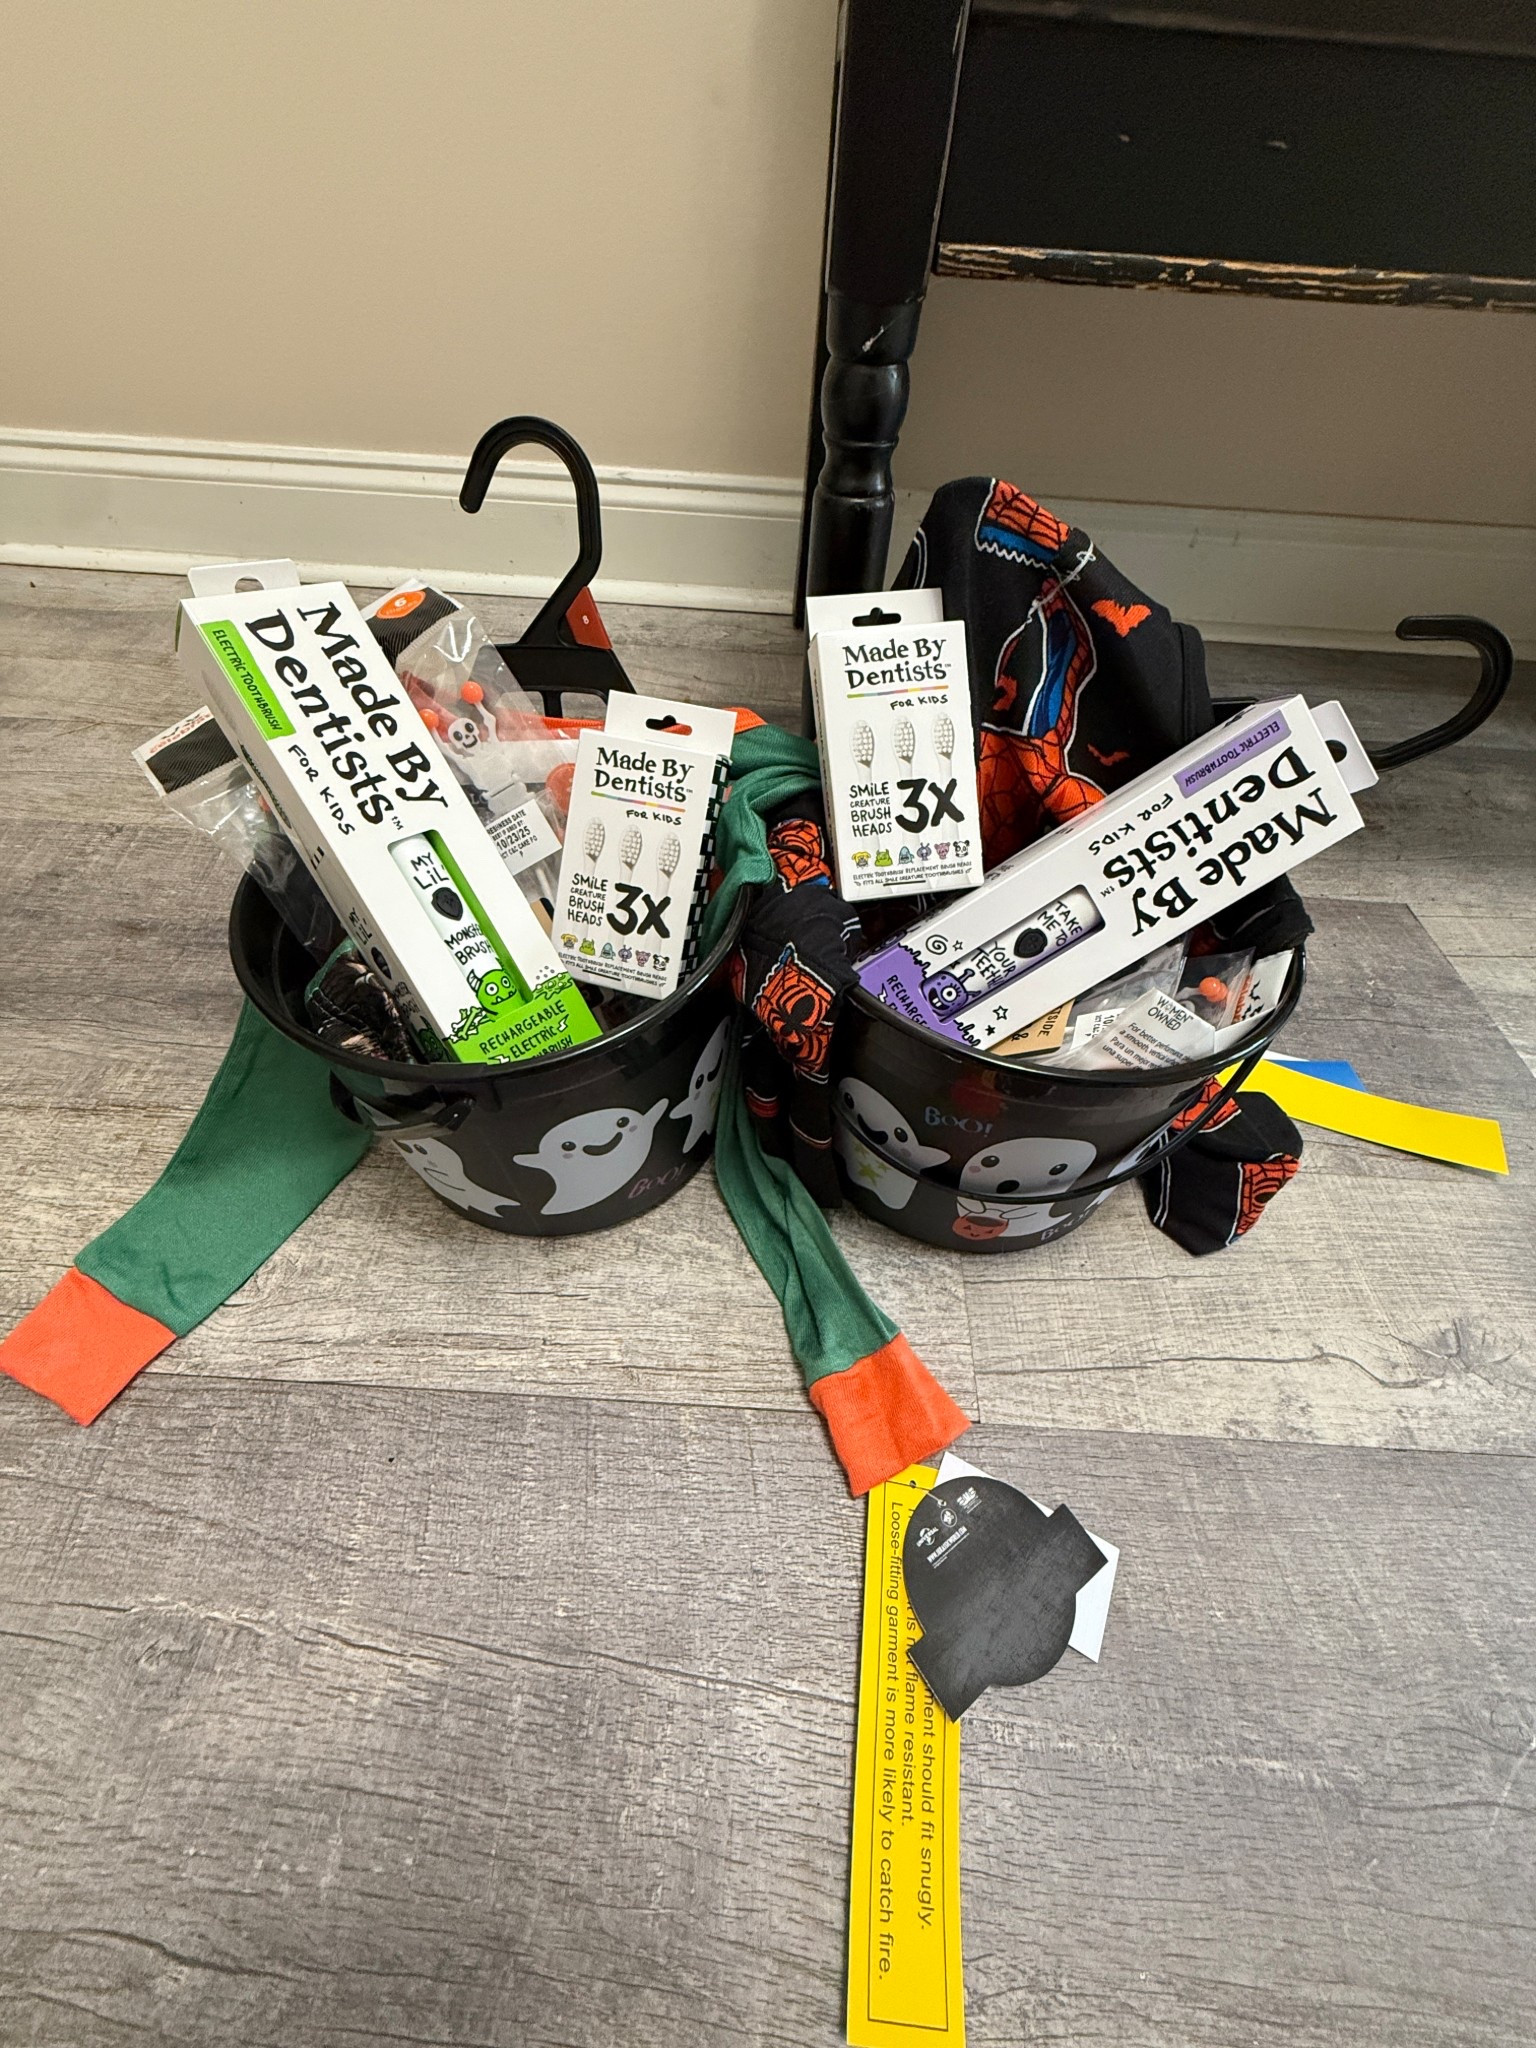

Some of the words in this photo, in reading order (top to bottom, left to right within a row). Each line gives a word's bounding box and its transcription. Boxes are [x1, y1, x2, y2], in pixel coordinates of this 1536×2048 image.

[842, 638, 909, 666] Made
[913, 638, 946, 662] By
[240, 668, 283, 731] TOOTHBRUSH
[296, 601, 400, 738] Made
[385, 741, 448, 809] By
[890, 699, 914, 711] FOR
[918, 694, 948, 705] KIDS
[595, 747, 657, 773] Made
[661, 758, 694, 784] By
[1184, 745, 1242, 788] TOOTHBRUSH
[288, 744, 319, 782] FOR
[320, 786, 356, 836] KIDS
[849, 797, 891, 808] CREATURE
[894, 778, 966, 834] 3X
[1137, 793, 1174, 822] FOR
[487, 816, 513, 835] RESHNESS
[511, 808, 527, 823] DATE
[625, 809, 648, 820] FOR
[652, 811, 682, 826] KIDS
[850, 806, 892, 823] BRUSH
[851, 822, 893, 837] HEADS
[495, 825, 532, 852] 10/23/25
[1088, 822, 1136, 856] KIDS
[1196, 787, 1338, 887] Made
[410, 852, 434, 872] MY
[568, 895, 605, 914] BRUSH
[570, 887, 606, 902] CREATURE
[606, 882, 672, 939] 3X
[1131, 876, 1199, 937] By
[567, 908, 603, 927] HEADS
[1037, 910, 1061, 932] ME
[1055, 929, 1069, 948] TO
[1055, 900, 1084, 937] TAKE
[454, 939, 495, 966] BRUSH
[988, 941, 1017, 978] YOUR
[886, 974, 930, 1030] RECHARG
[1147, 1006, 1182, 1031] OWNED
[479, 999, 567, 1055] RECHARGEABLE
[1128, 1022, 1141, 1033] For
[1139, 1028, 1157, 1045] better
[1102, 1043, 1117, 1057] una
[1110, 1035, 1126, 1051] Para
[1124, 1046, 1135, 1057] un
[886, 1501, 904, 1601] Loose-fitting
[886, 1604, 900, 1681] garment
[885, 1686, 900, 1703] is
[904, 1671, 919, 1725] flame
[923, 1684, 936, 1738] ment
[883, 1709, 897, 1761] more
[878, 1767, 897, 1823] likely
[901, 1731, 917, 1827] resistant.
[921, 1743, 936, 1814] should
[881, 1829, 895, 1851] to
[921, 1820, 936, 1842] fit
[879, 1858, 894, 1924] catch
[917, 1847, 936, 1930] snugly.
[878, 1932, 895, 1980] fire.
